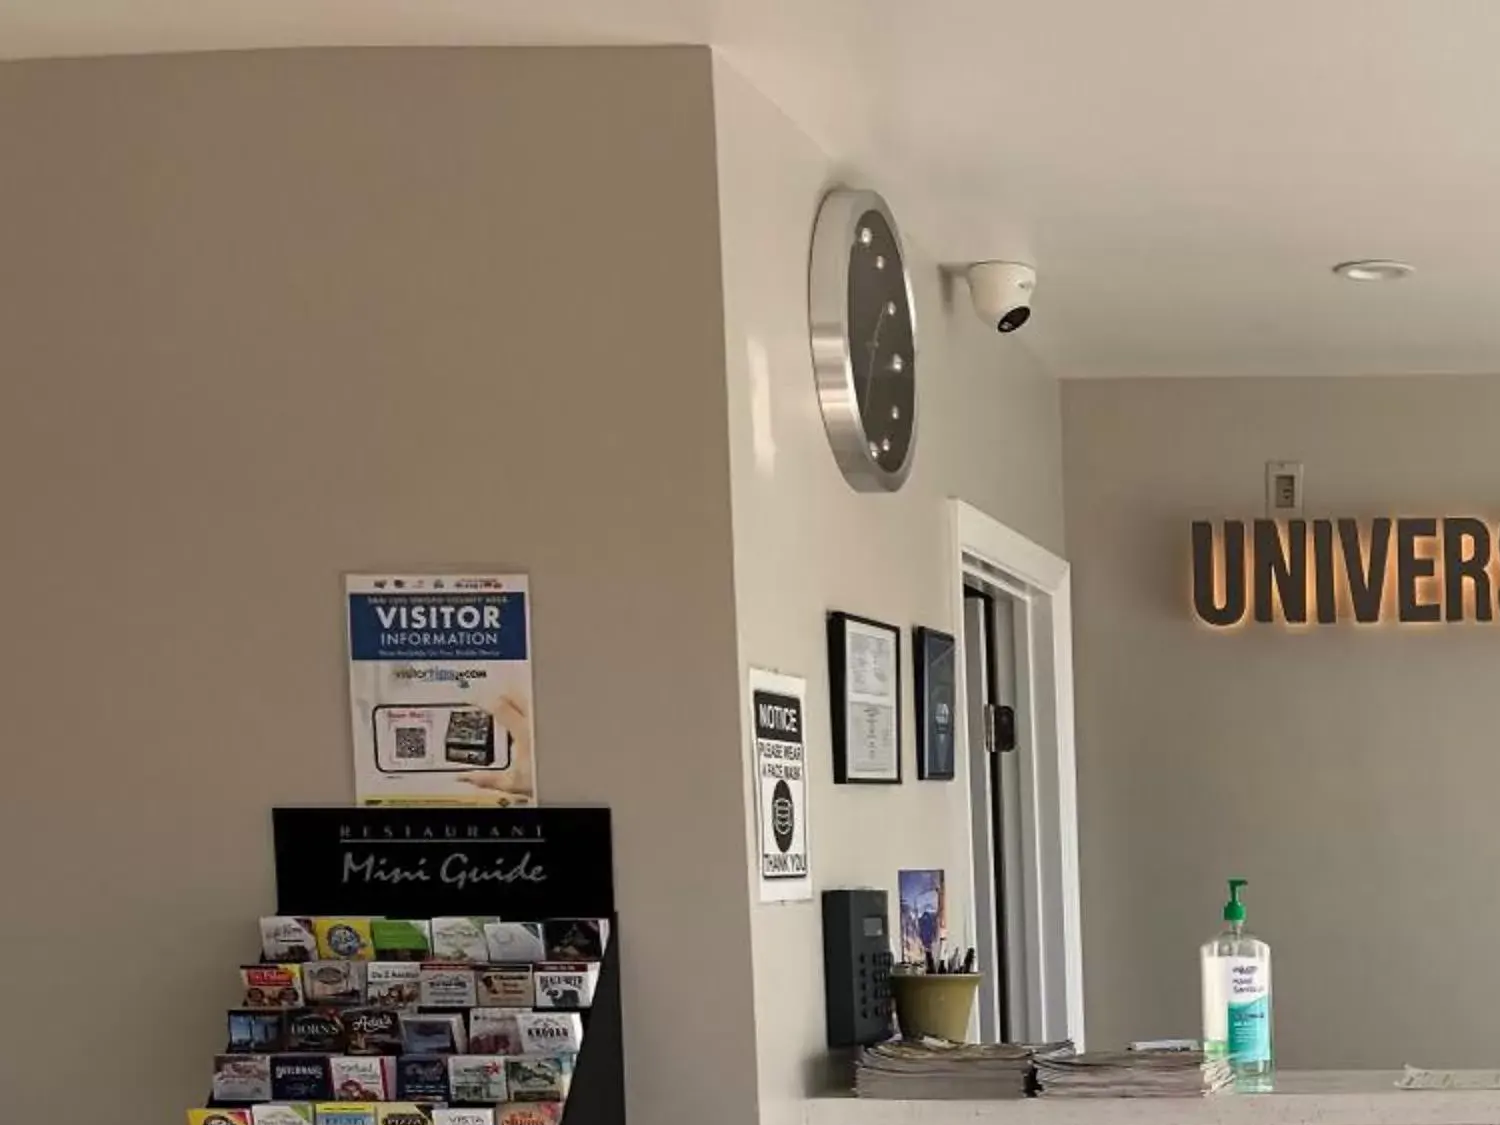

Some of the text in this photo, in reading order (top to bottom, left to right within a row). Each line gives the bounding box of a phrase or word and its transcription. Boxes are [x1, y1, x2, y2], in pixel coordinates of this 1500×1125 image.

[376, 605, 502, 629] VISITOR
[381, 632, 498, 646] INFORMATION
[759, 703, 799, 735] NOTICE
[759, 742, 802, 760] PLEASE WEAR
[339, 824, 543, 839] RESTAURANT
[341, 850, 548, 891] Mini Guide
[764, 853, 808, 873] THANK YOU
